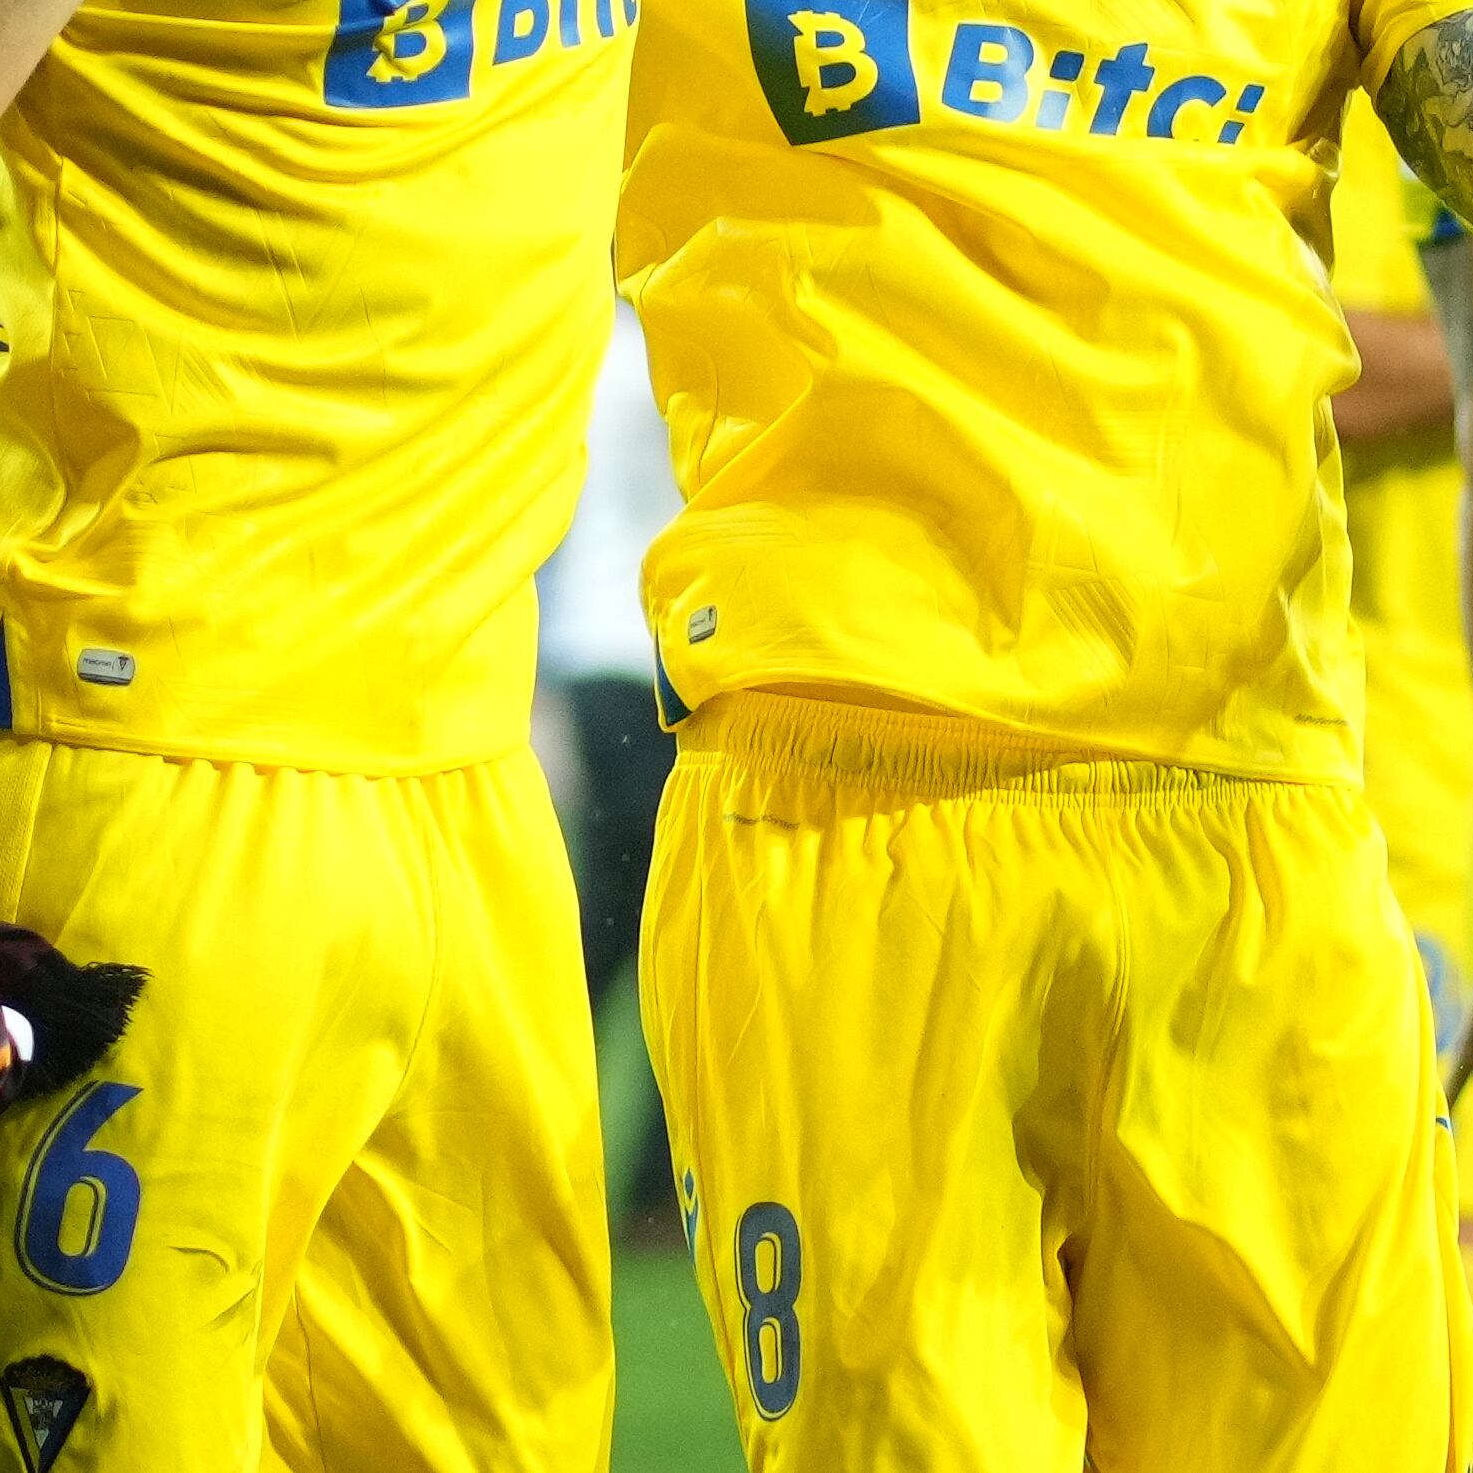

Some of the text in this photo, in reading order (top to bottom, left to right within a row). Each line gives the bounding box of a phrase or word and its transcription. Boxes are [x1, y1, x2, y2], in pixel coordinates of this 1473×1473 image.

[941, 23, 1265, 146] Bitci
[14, 1080, 144, 1297] 6
[734, 1201, 802, 1422] 8
